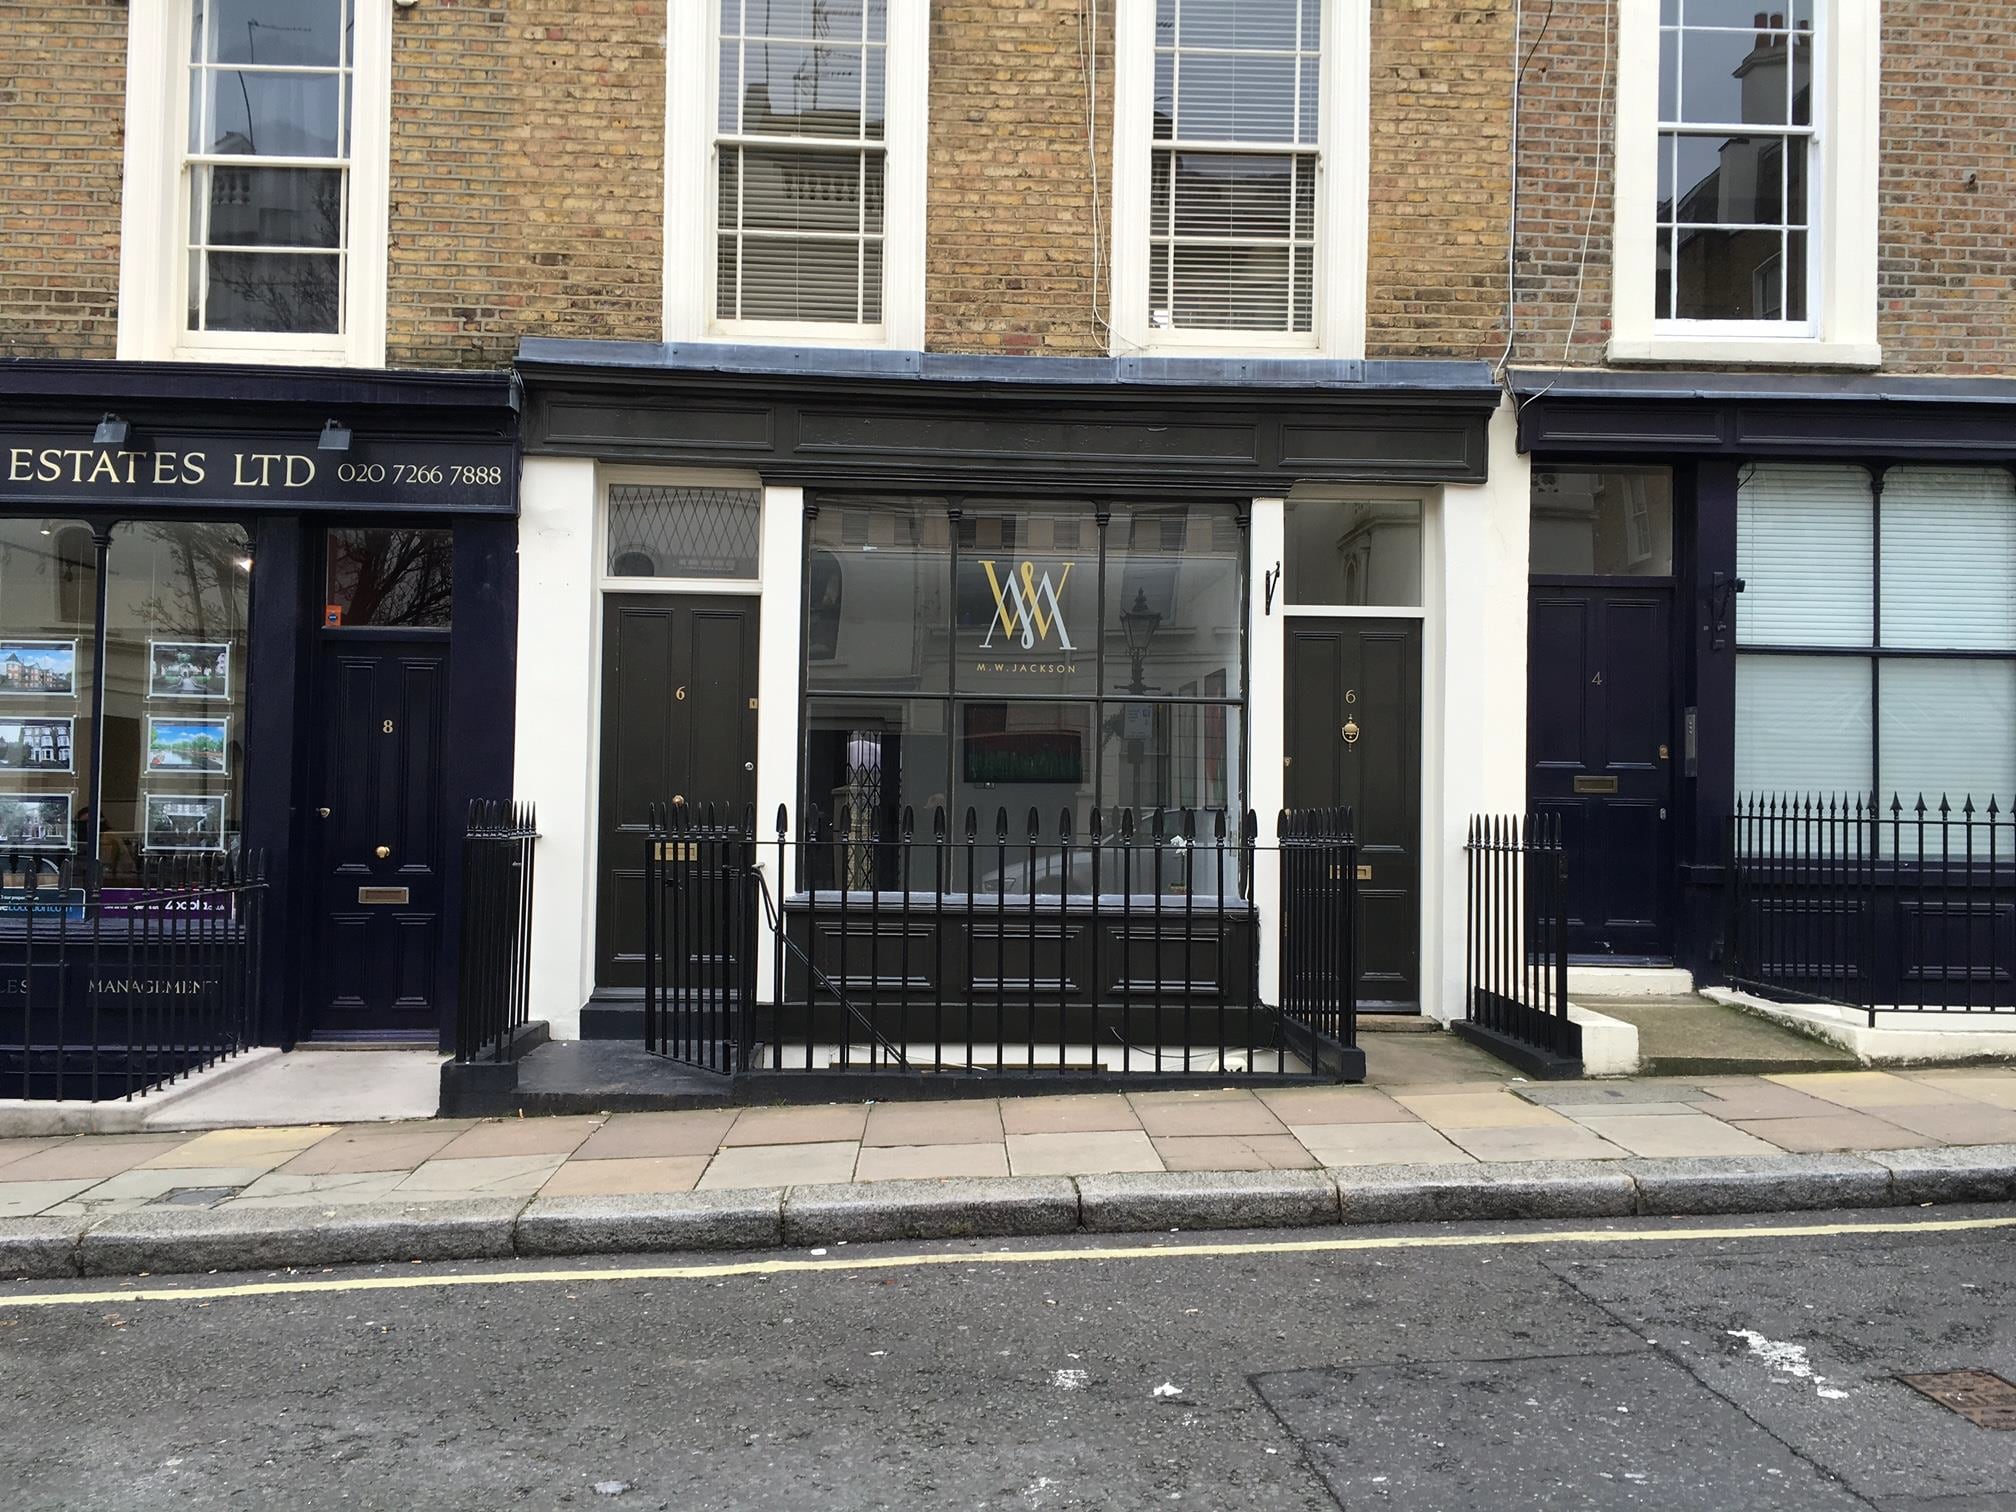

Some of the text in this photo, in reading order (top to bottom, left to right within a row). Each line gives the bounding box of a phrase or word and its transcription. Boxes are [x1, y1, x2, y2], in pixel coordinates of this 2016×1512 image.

[8, 448, 501, 487] ESTATES LTD 020 7266 7888
[1591, 671, 1603, 685] 4
[675, 686, 686, 701] 6
[1345, 689, 1356, 704] 6
[382, 719, 394, 734] 8
